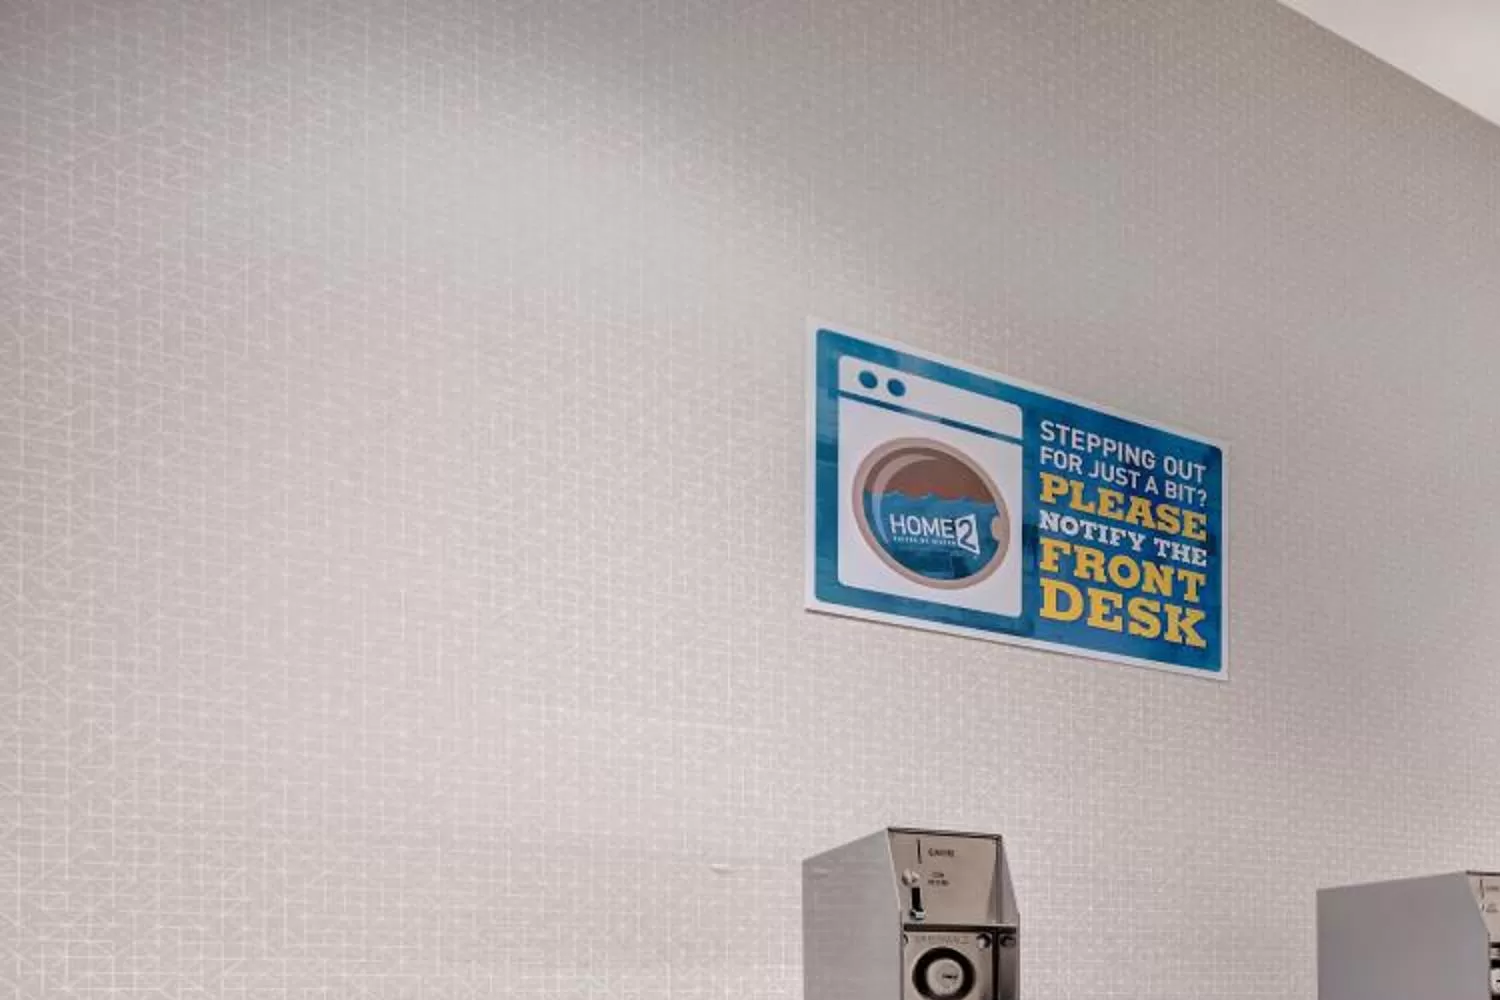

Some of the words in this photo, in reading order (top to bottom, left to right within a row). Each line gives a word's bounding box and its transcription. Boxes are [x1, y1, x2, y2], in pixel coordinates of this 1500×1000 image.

[1040, 419, 1157, 470] STEPPING
[1163, 455, 1207, 483] OUT
[1040, 446, 1084, 475] FOR
[1088, 460, 1141, 489] JUST
[1144, 475, 1159, 495] A
[1165, 480, 1208, 507] BIT?
[1039, 471, 1208, 542] PLEASE
[1039, 509, 1147, 552] NOTIFY
[1154, 537, 1207, 568] THE
[1039, 536, 1206, 603] FRONT
[1039, 578, 1207, 648] DESK
